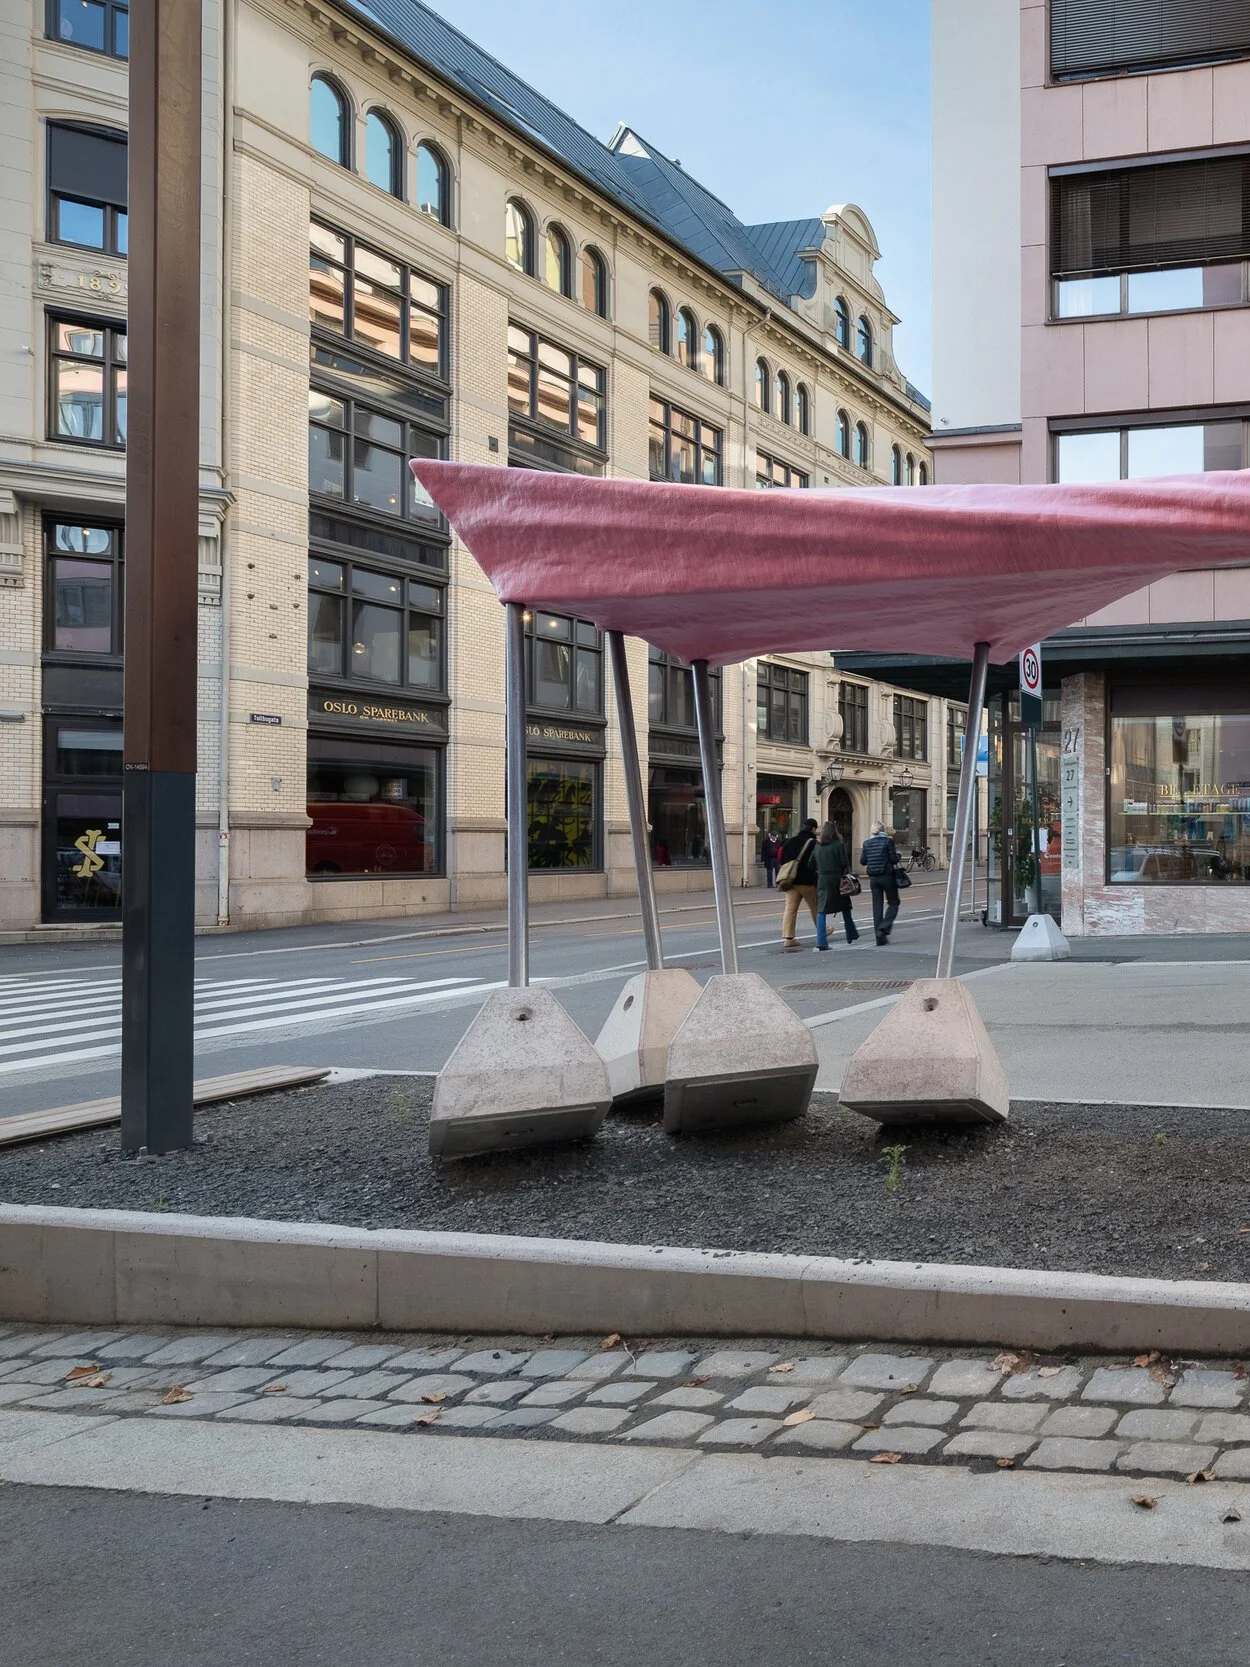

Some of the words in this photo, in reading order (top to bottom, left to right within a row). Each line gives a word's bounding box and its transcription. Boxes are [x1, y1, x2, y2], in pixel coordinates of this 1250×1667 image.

[78, 274, 128, 296] 189
[1026, 657, 1036, 680] 30
[324, 701, 358, 714] OSLO
[363, 705, 430, 723] SPAREBANK
[543, 728, 592, 742] SPAREBANK
[1064, 727, 1080, 754] 27
[1066, 769, 1075, 781] 27
